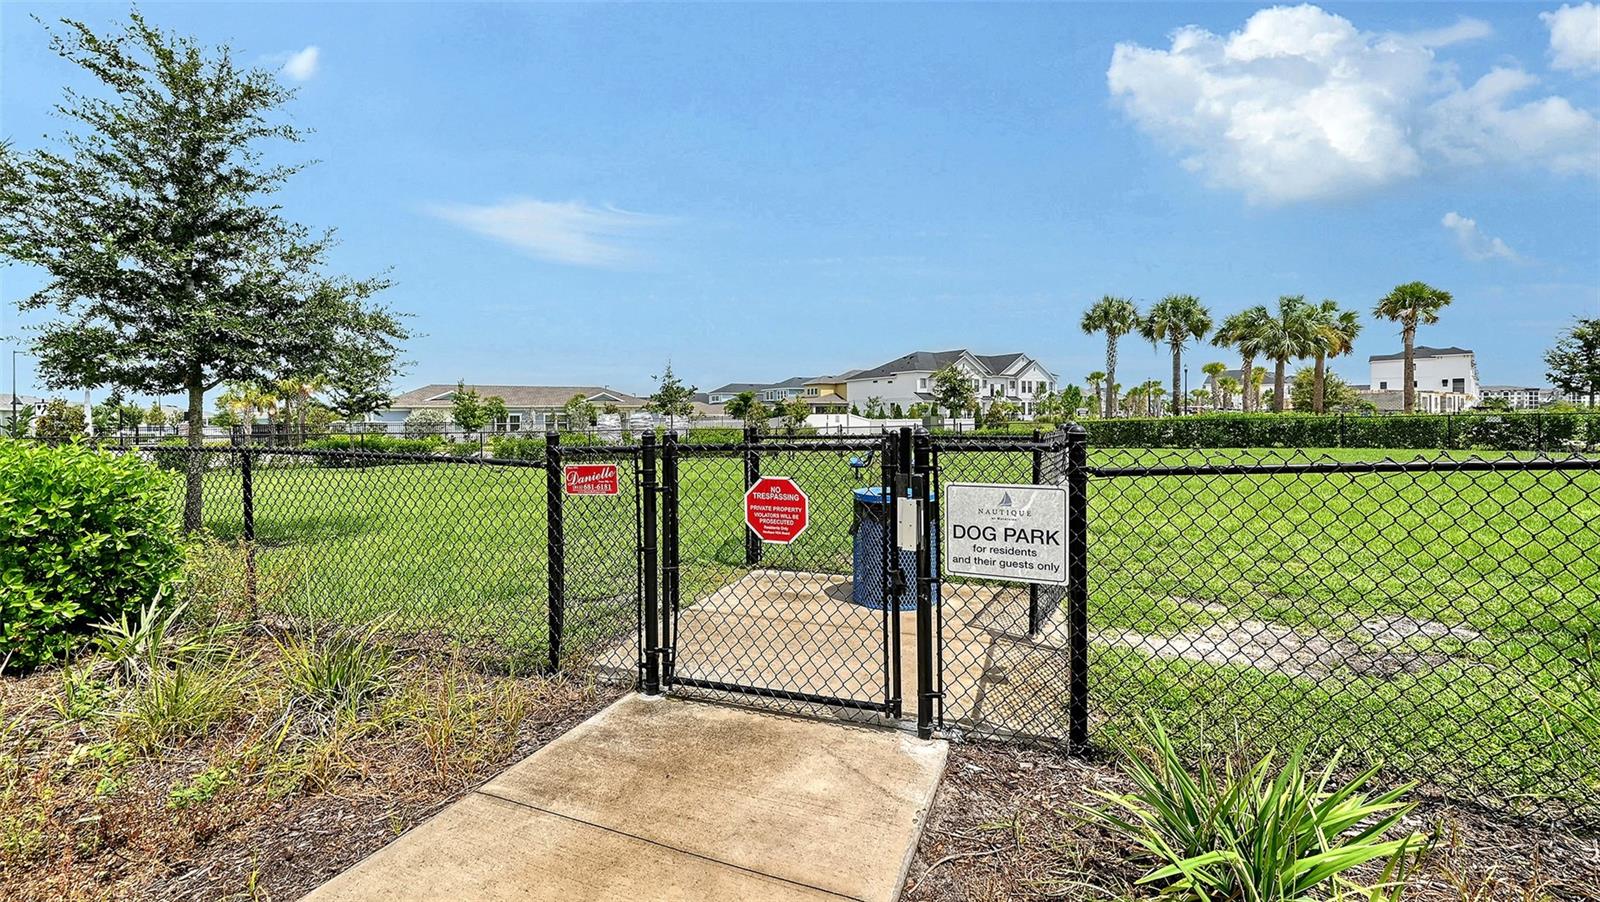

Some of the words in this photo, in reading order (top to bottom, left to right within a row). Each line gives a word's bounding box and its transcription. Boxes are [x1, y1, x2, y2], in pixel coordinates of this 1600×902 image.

[566, 467, 615, 486] Danielle
[752, 492, 800, 501] TRESPASSING
[770, 486, 781, 494] NO
[978, 508, 1032, 517] NAUTIQUE
[953, 524, 997, 542] DOG
[1004, 527, 1060, 546] PARK
[973, 544, 987, 554] for
[990, 546, 1038, 557] residents
[952, 556, 971, 564] and
[974, 557, 996, 566] their
[999, 559, 1034, 570] guests
[1037, 562, 1060, 573] only
